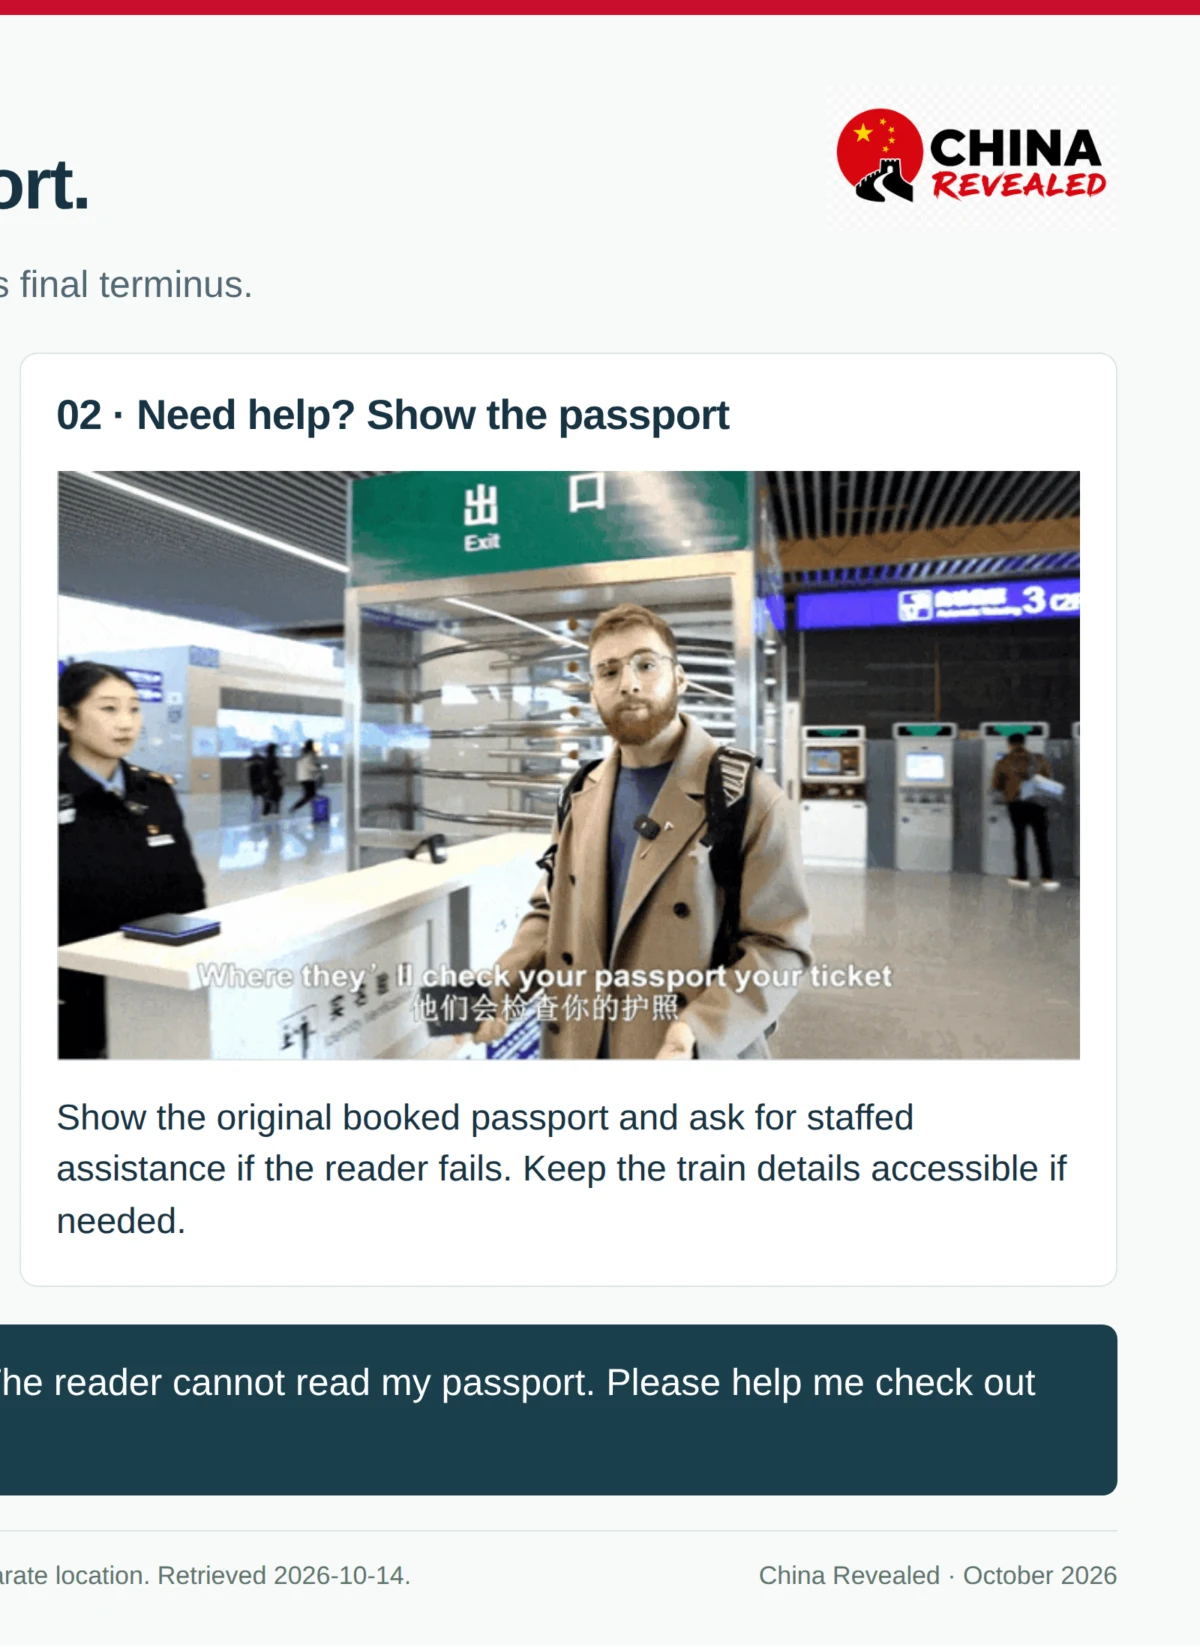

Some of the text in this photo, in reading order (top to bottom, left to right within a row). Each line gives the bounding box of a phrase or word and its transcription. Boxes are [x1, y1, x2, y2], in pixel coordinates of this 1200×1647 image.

[930, 128, 1102, 167] CHINA
[931, 170, 1107, 202] REVEALED
[20, 269, 87, 298] final
[99, 269, 250, 298] terminus.
[57, 399, 101, 430] 02
[139, 398, 235, 430] Need
[249, 398, 354, 438] help?
[367, 398, 476, 430] Show
[486, 398, 547, 430] the
[560, 401, 730, 438] passport
[464, 472, 605, 526] 出口
[464, 532, 501, 552] Exit
[1022, 585, 1047, 615] 3
[58, 1103, 912, 1137] Show the original booked passport and ask for staffed
[57, 1154, 1068, 1188] assistance if the reader fails. Keep the train details accessible if
[58, 1206, 184, 1234] needed.
[56, 1367, 162, 1396] reader
[174, 1370, 285, 1396] cannot
[297, 1367, 369, 1396] read
[383, 1374, 431, 1403] my
[443, 1370, 593, 1404] passport.
[609, 1367, 720, 1396] Please
[733, 1367, 801, 1403] help
[814, 1374, 863, 1396] me
[876, 1367, 973, 1396] check
[984, 1370, 1036, 1396] out
[57, 1565, 148, 1584] location.
[159, 1565, 265, 1585] Retrieved
[274, 1566, 409, 1584] 2026-10-14.
[760, 1565, 826, 1584] China
[834, 1565, 939, 1585] Revealed
[964, 1565, 1054, 1584] October
[1062, 1566, 1117, 1584] 2026
